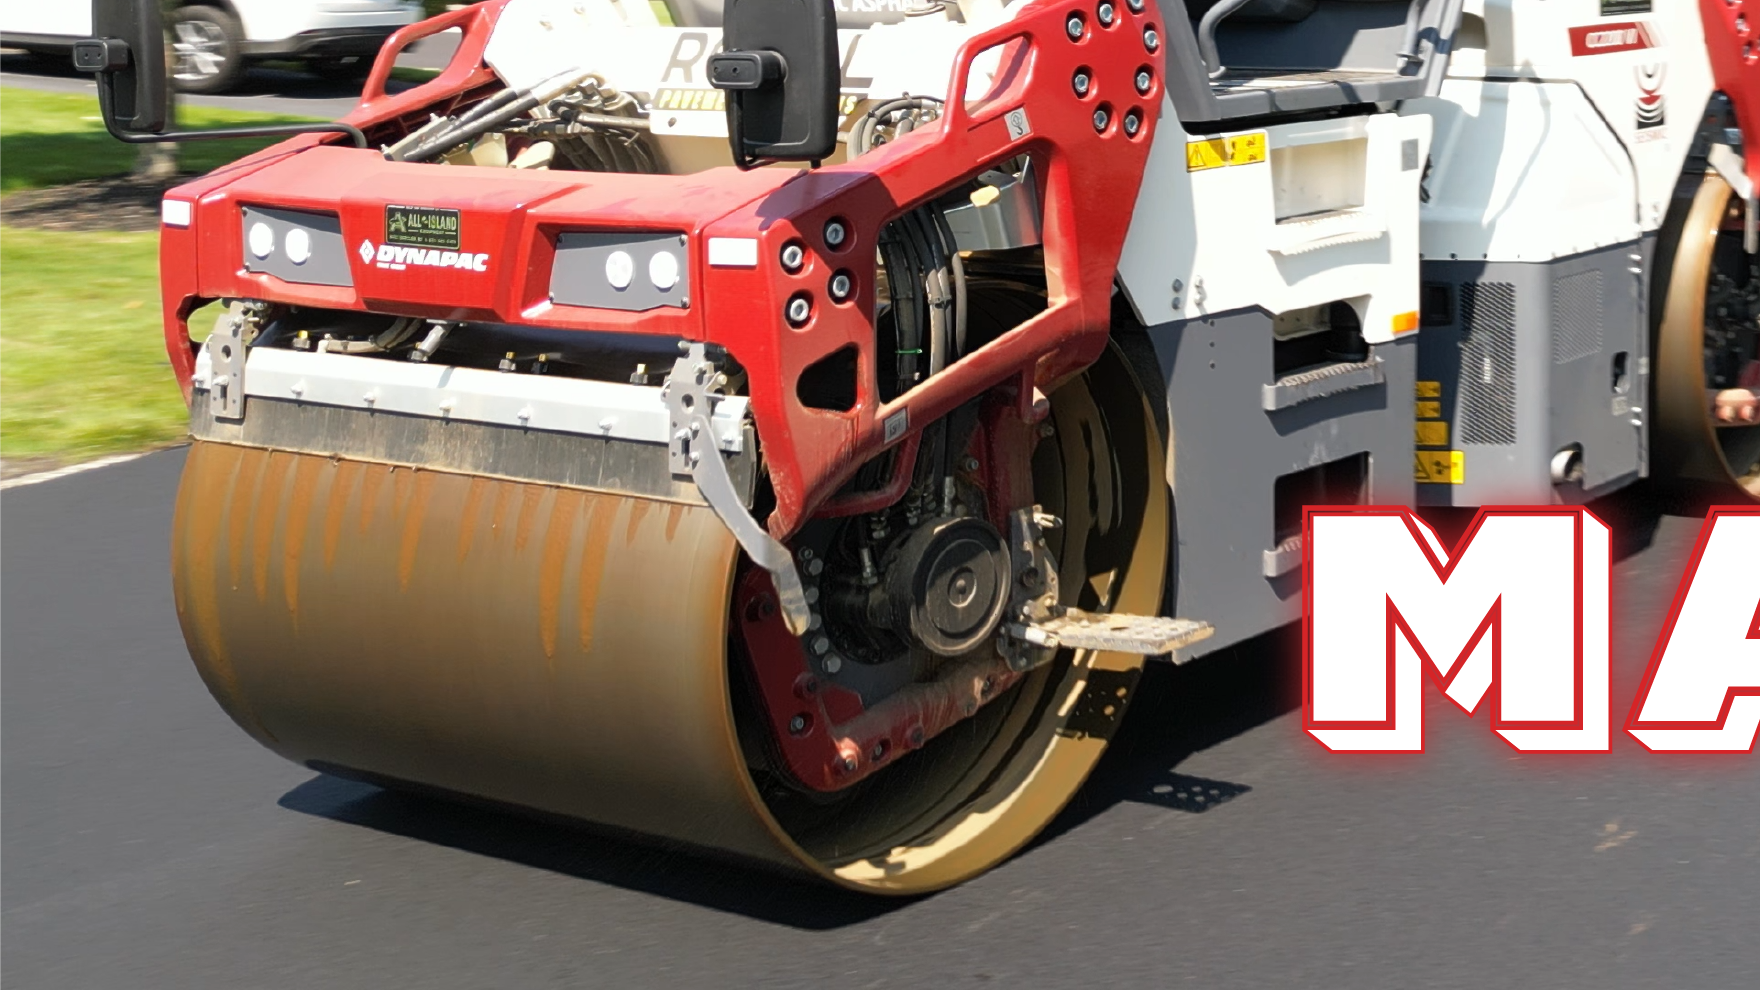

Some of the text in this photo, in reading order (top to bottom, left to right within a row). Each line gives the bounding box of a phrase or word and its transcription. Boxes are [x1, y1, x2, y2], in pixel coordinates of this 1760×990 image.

[407, 213, 457, 231] ALL ISLAND
[376, 244, 489, 271] DYNAPAC
